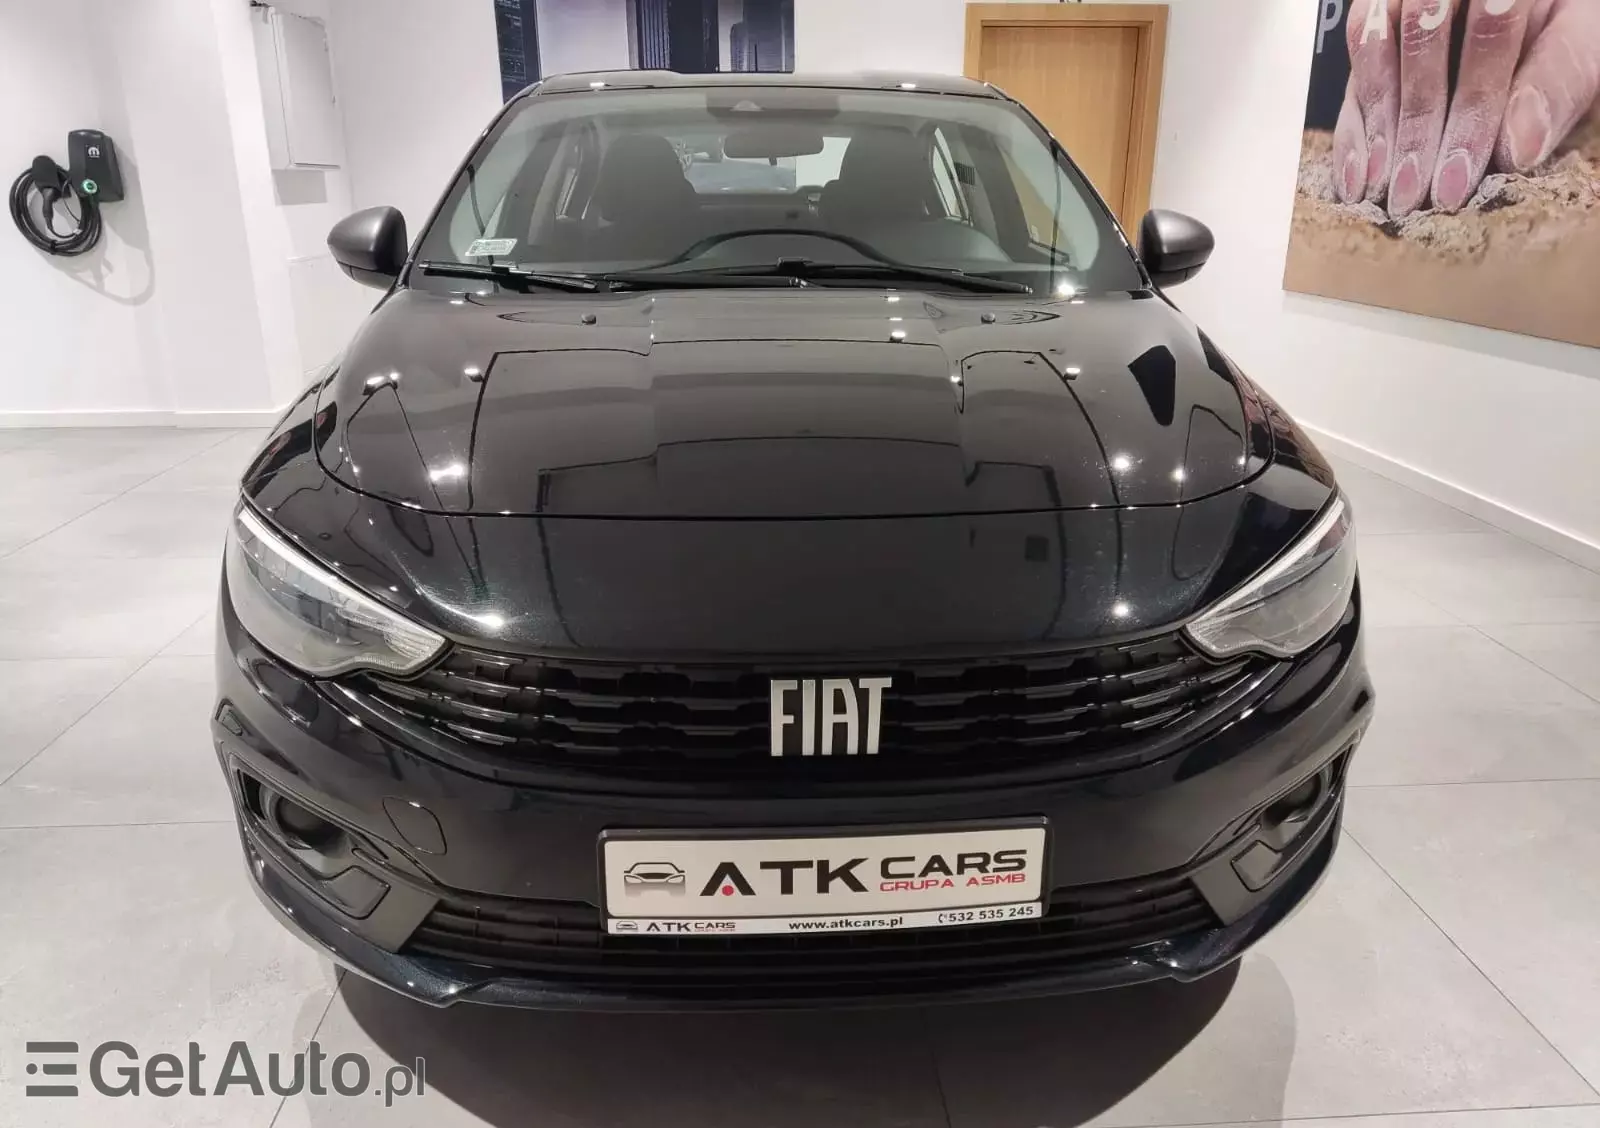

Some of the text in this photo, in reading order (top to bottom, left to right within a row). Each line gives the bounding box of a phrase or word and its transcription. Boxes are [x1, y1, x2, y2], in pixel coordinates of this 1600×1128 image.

[770, 677, 892, 757] FIAT
[700, 849, 1027, 896] ATK CARS
[880, 873, 1026, 892] GRUPA ASMB
[949, 906, 1034, 922] 532 535 245
[646, 922, 691, 932] ATK
[788, 916, 903, 931] www.atkcars.pl
